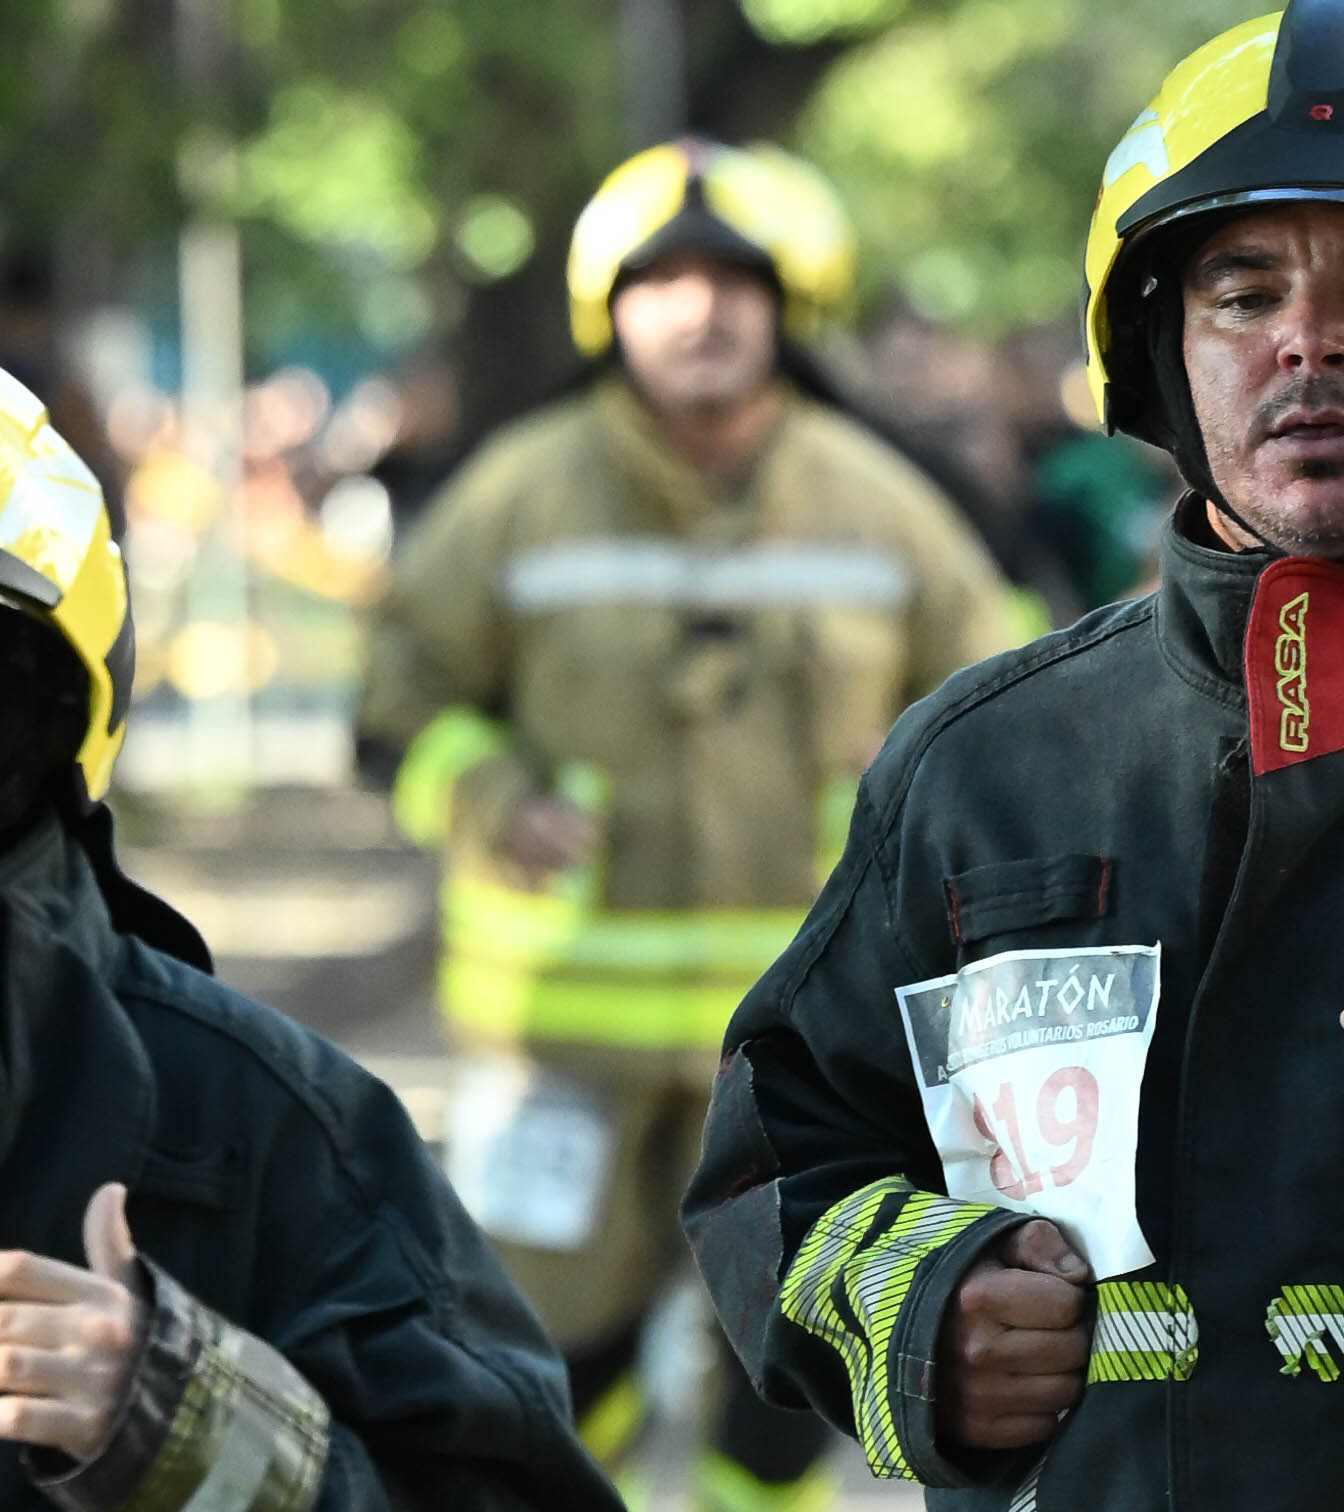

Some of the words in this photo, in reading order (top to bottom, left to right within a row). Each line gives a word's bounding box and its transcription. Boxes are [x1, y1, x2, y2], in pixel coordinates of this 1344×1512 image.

[1275, 592, 1309, 752] RASA
[959, 964, 1115, 1036] MARATÓN
[1007, 1024, 1084, 1051] VOLUNTARIOS
[1087, 1015, 1139, 1037] ROSARIO
